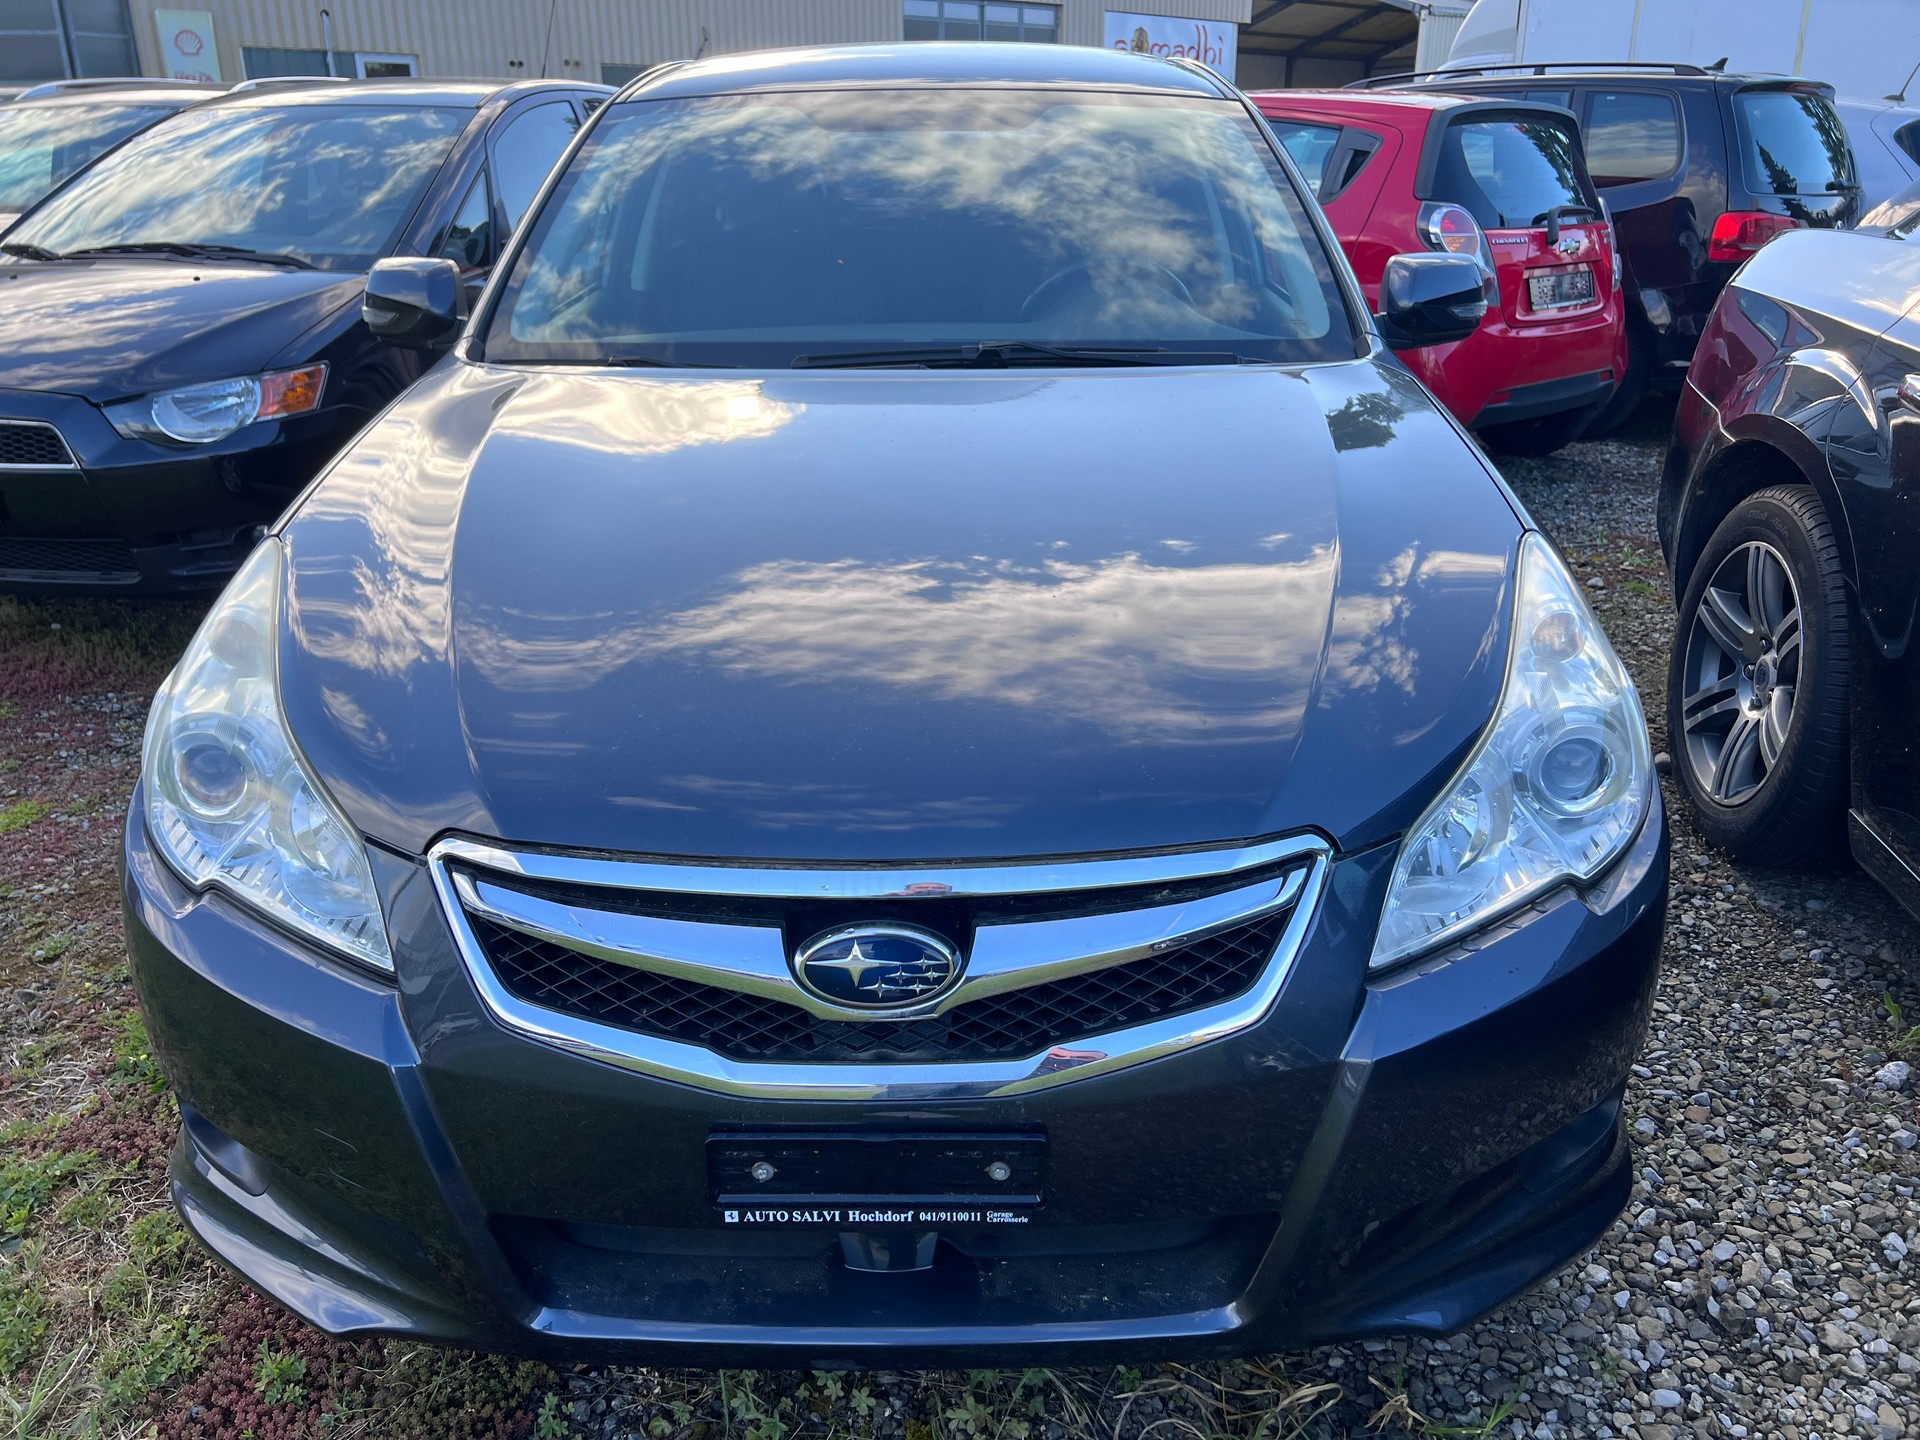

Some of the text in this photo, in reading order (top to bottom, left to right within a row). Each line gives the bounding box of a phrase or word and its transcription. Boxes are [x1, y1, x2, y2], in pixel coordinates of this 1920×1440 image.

[743, 1210, 981, 1222] AUTO SALVI Hochdorf 041/9110011
[986, 1210, 1014, 1218] Garage
